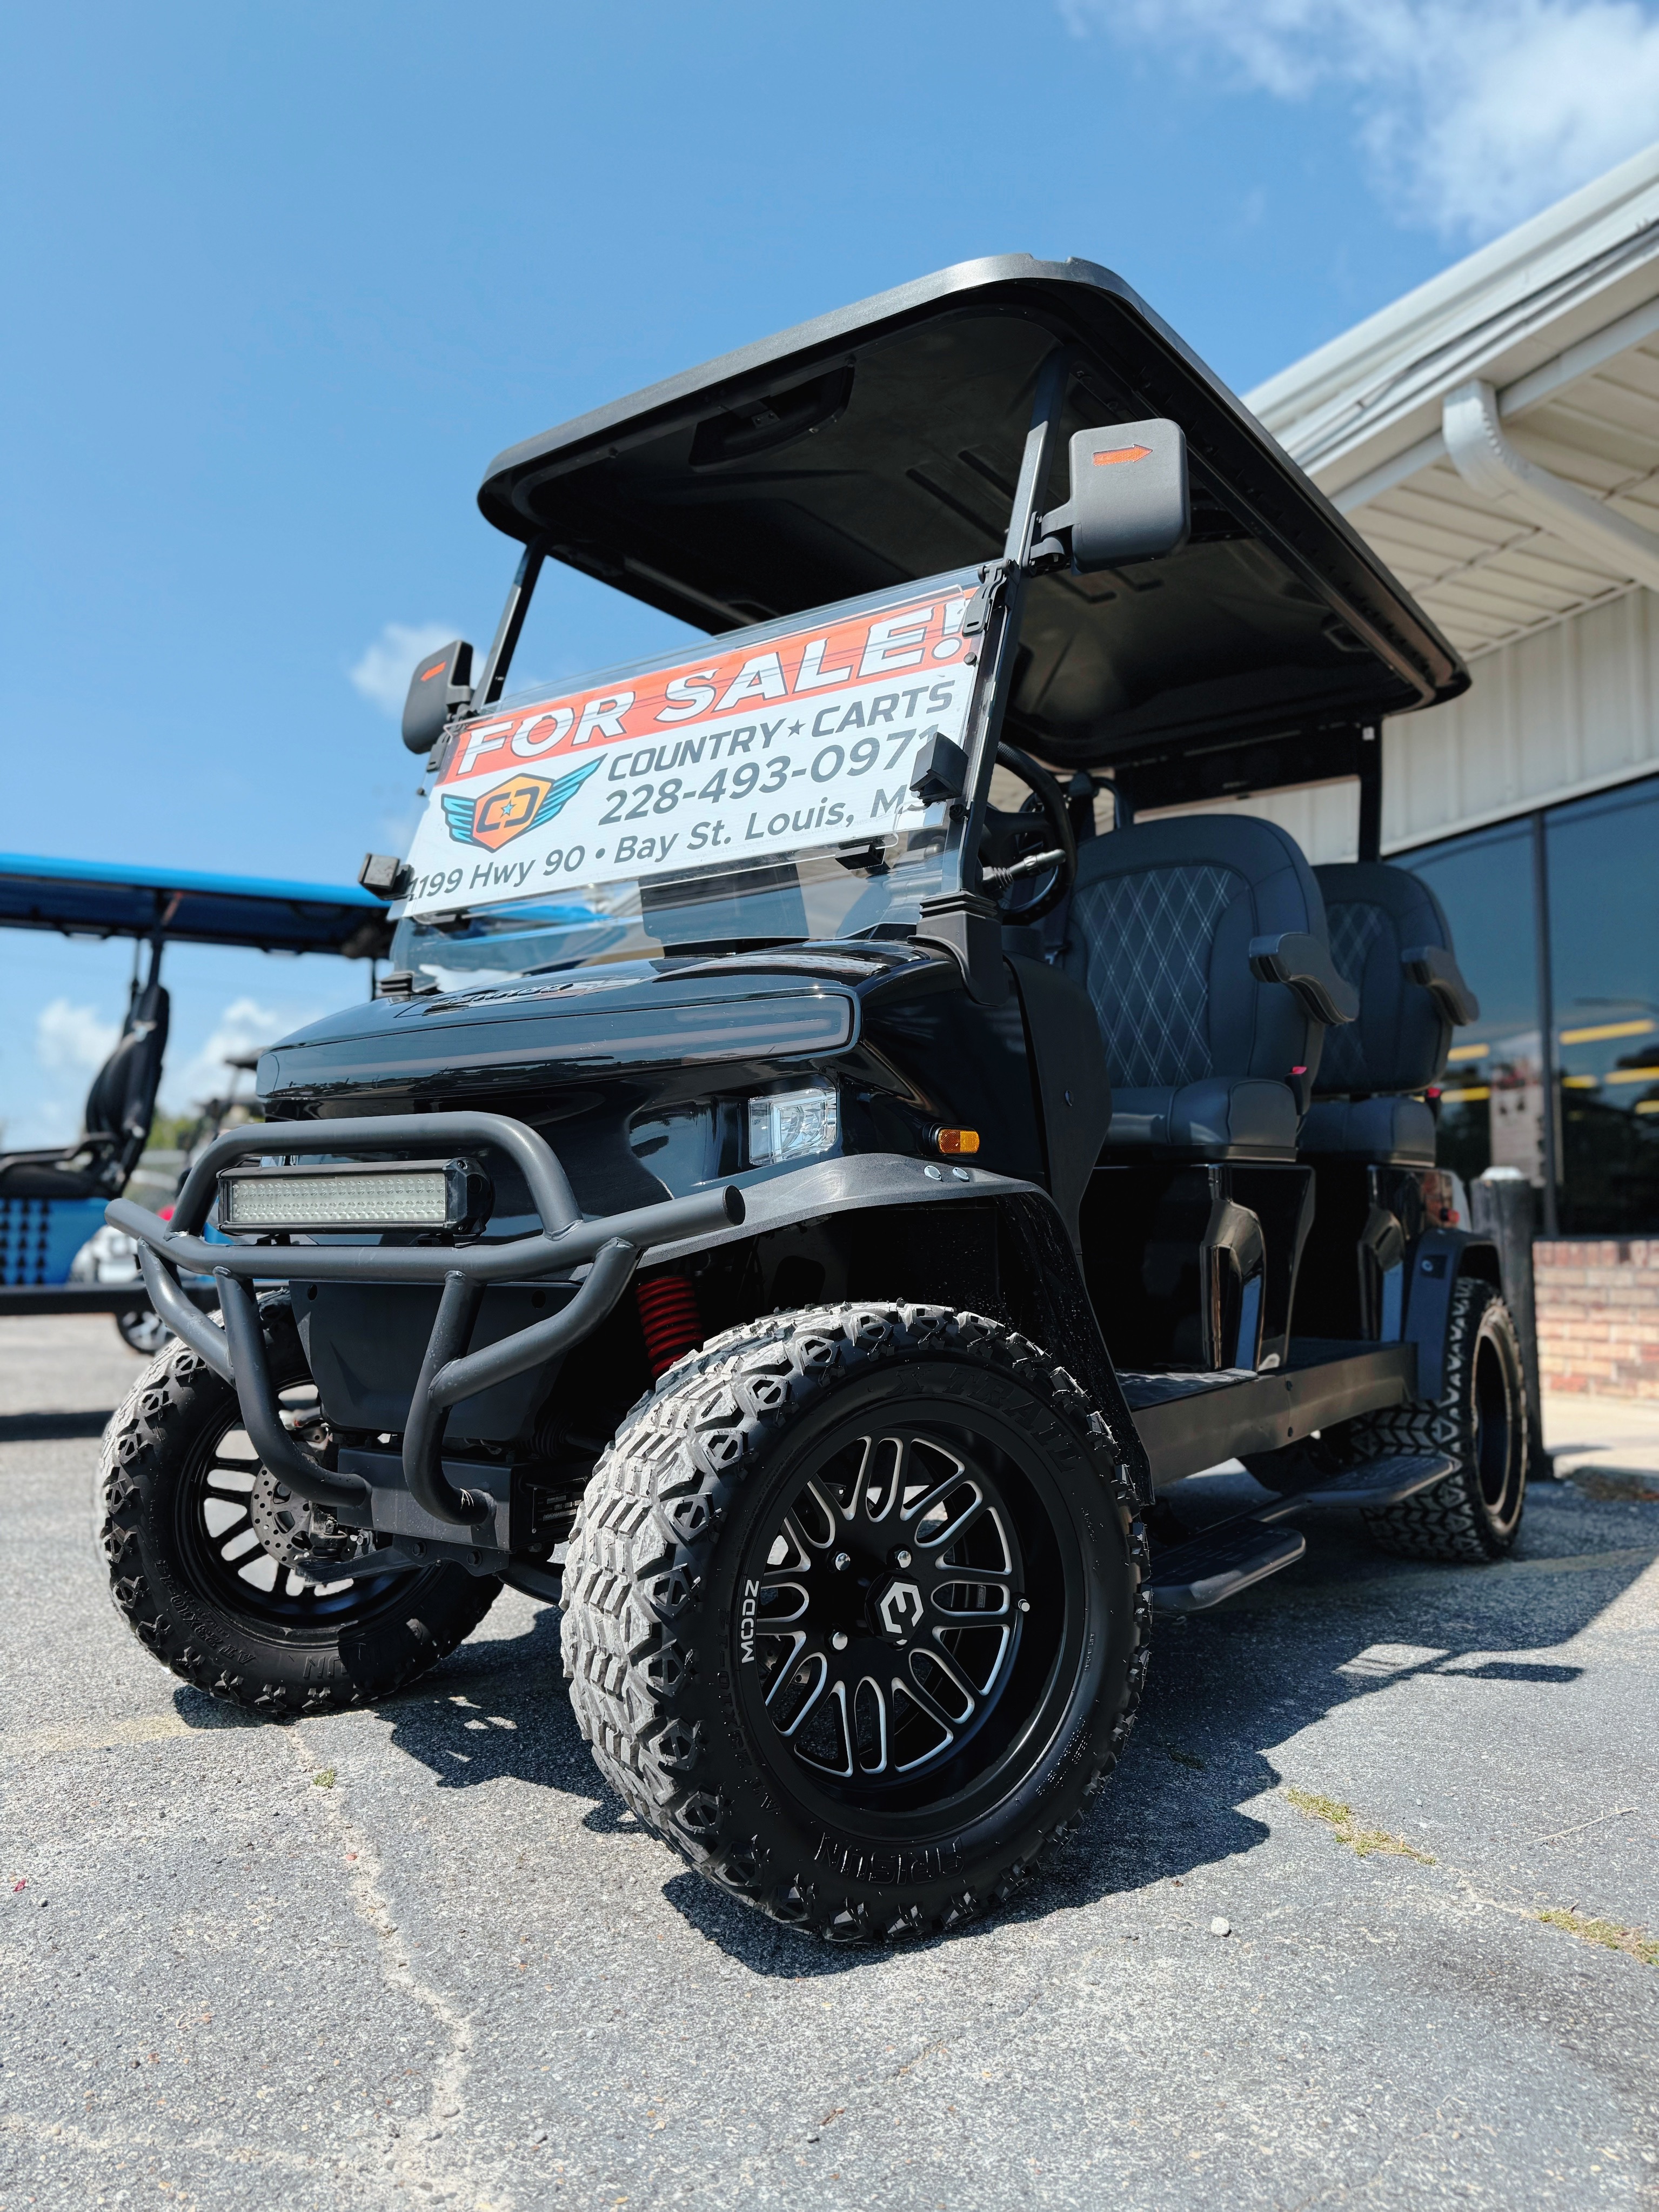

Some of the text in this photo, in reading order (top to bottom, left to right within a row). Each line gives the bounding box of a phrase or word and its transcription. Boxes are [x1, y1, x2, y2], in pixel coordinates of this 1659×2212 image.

[456, 598, 971, 776] FOR SALE!
[608, 680, 955, 781] COUNTRY CARTS
[409, 868, 463, 901] 1199
[469, 860, 536, 889] Hwy
[543, 846, 585, 876] 90
[614, 833, 679, 863] Bay
[687, 820, 731, 850] St.
[745, 797, 854, 840] Louis,
[943, 1367, 1079, 1473] TRAIL
[218, 1644, 256, 1666] AT
[741, 1579, 759, 1664] MODZ
